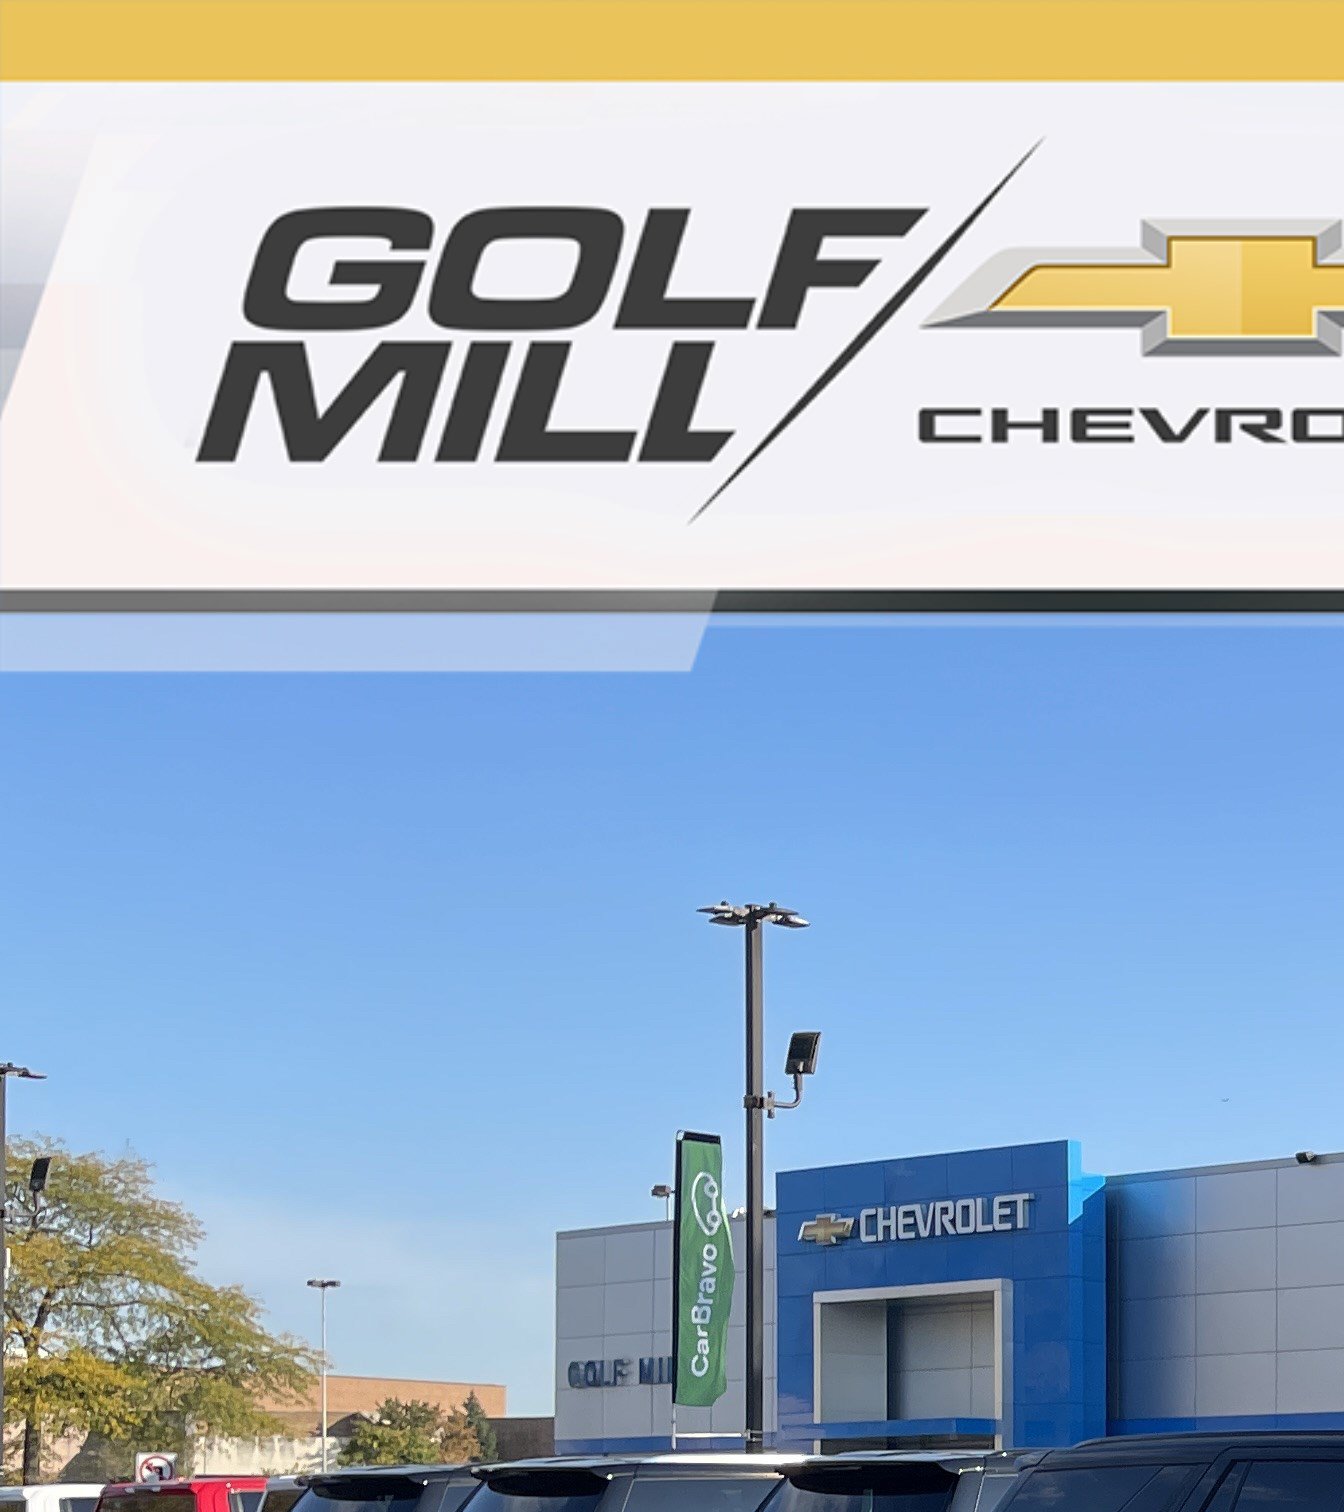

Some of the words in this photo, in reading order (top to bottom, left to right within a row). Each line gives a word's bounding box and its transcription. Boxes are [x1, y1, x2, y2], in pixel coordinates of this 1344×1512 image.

[860, 1193, 1034, 1243] CHEVROLET
[691, 1243, 718, 1377] CarBravo
[568, 1359, 628, 1388] GOLF
